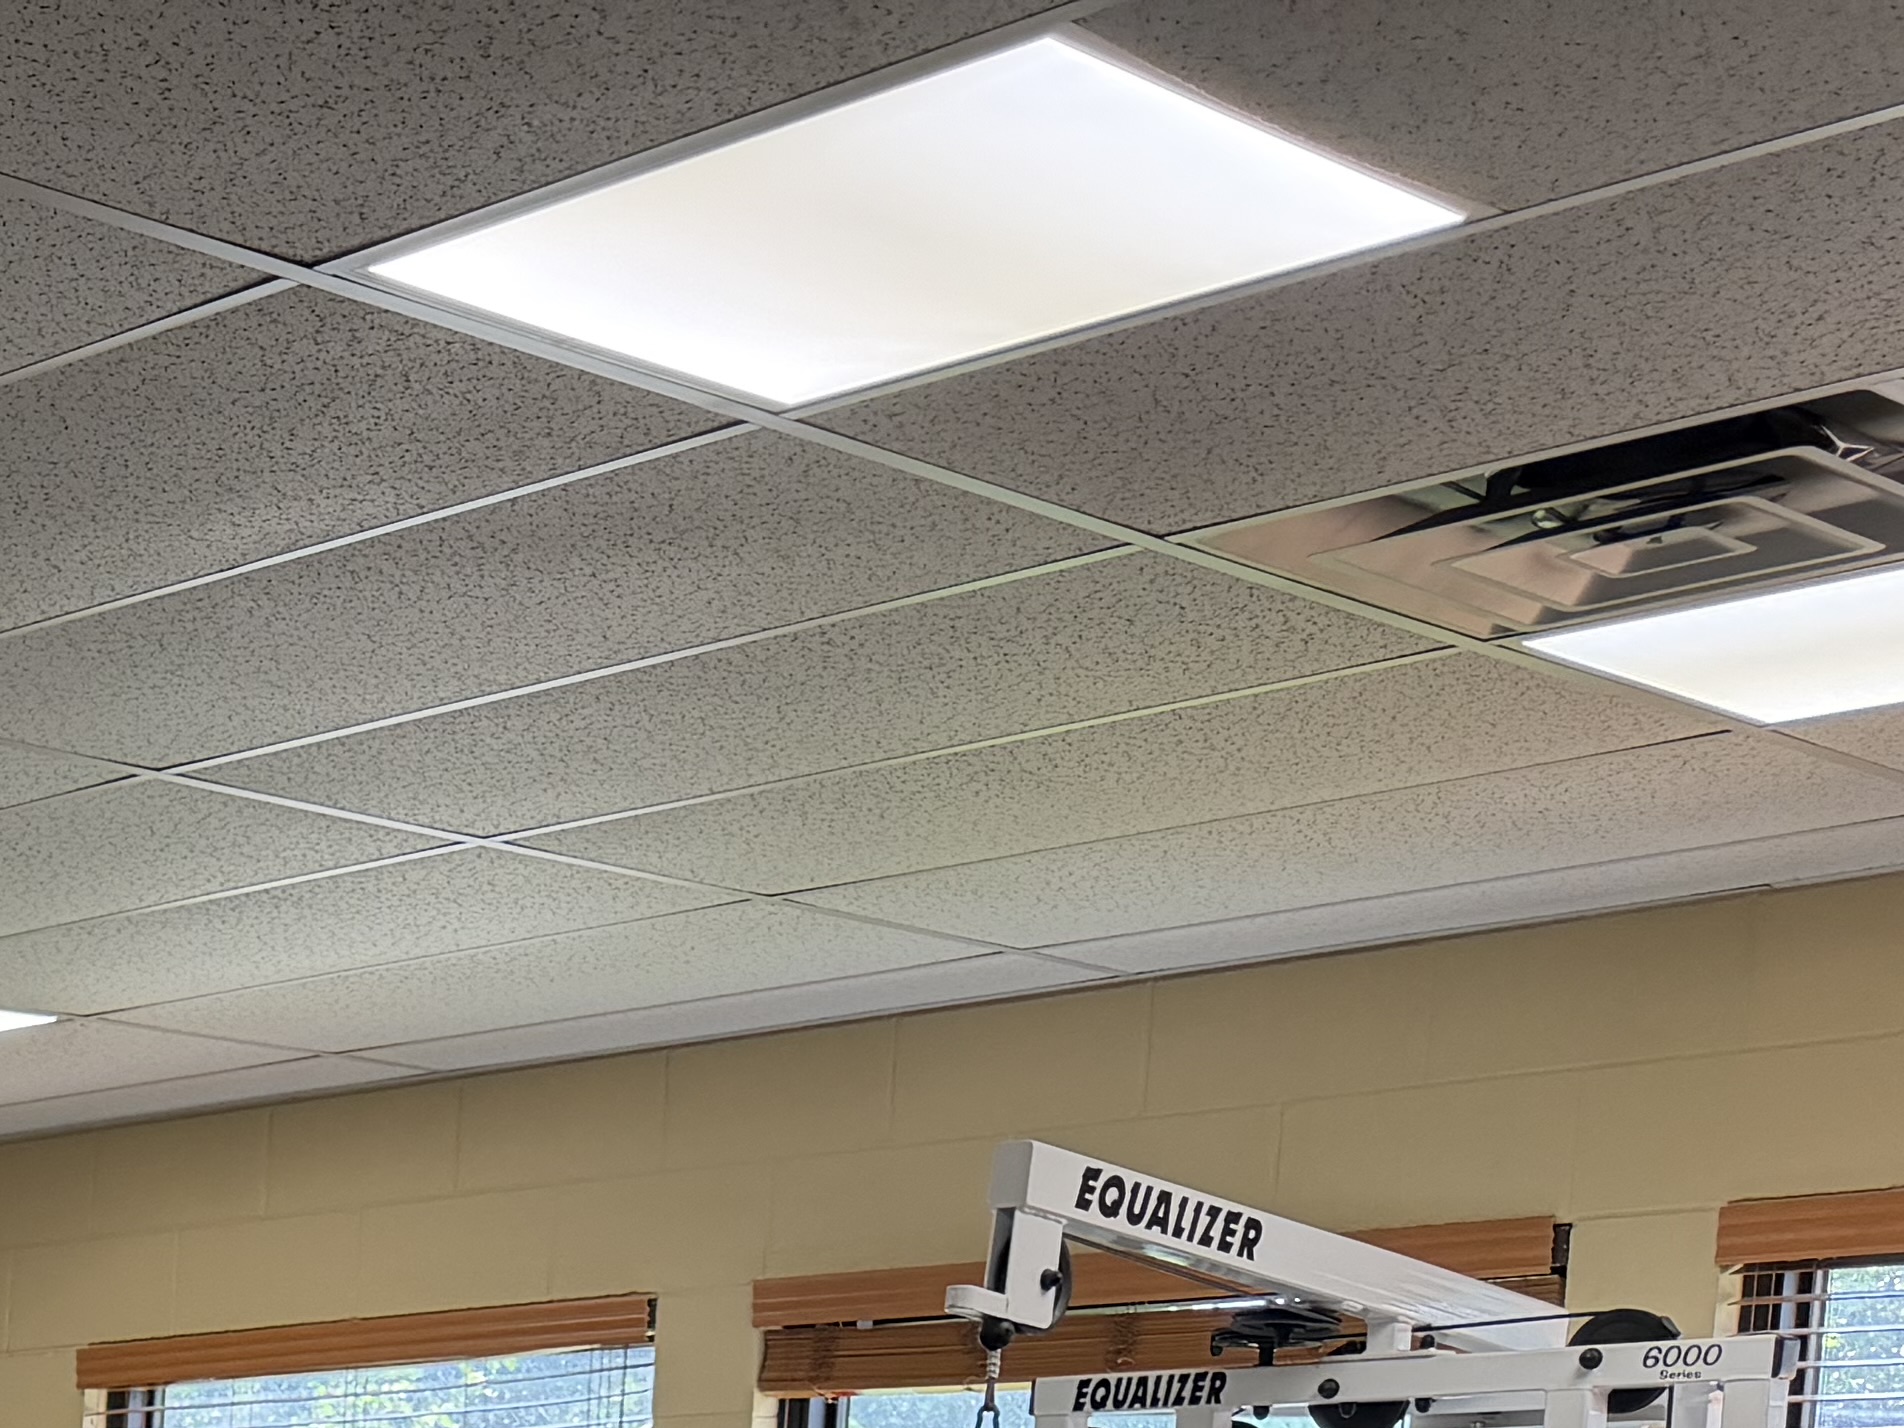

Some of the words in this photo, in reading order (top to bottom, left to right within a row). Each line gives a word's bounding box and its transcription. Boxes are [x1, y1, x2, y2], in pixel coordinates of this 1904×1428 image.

[1074, 1166, 1263, 1261] EQUALIZER
[1642, 1344, 1723, 1368] 6000
[1659, 1369, 1702, 1380] Series
[1072, 1371, 1227, 1412] EQUALIZER
